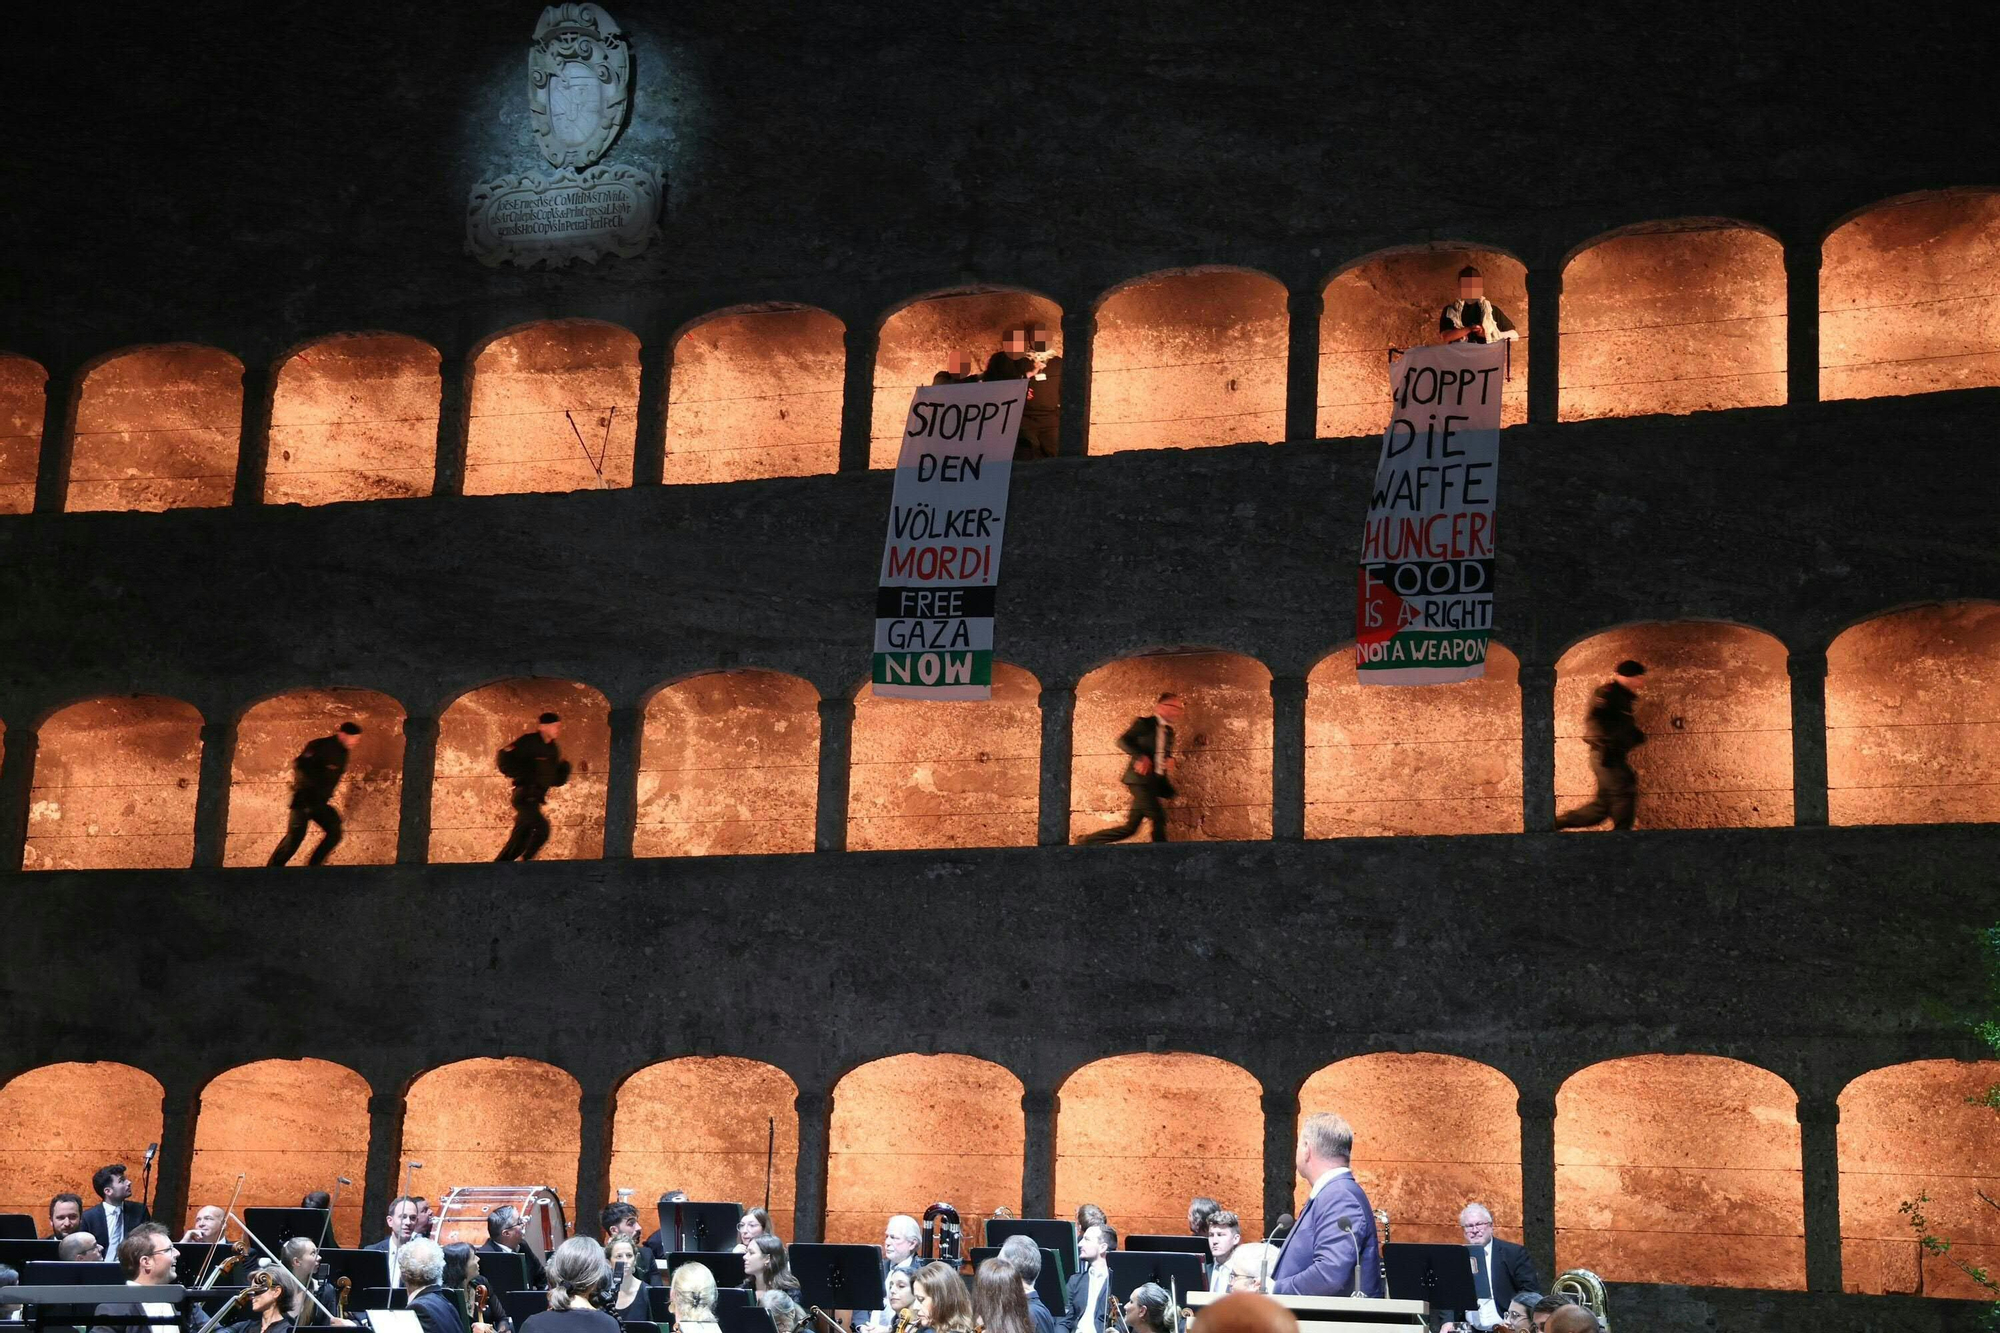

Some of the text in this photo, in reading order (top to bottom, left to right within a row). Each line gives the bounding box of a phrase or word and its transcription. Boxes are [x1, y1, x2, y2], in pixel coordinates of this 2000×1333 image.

[907, 399, 1018, 441] STOPPT
[917, 453, 983, 482] DEN
[1371, 462, 1492, 511] WAFFE
[894, 502, 1000, 541] VÖLKER-
[1362, 511, 1497, 561] HUNGER!
[888, 545, 991, 583] MORD!
[1365, 561, 1485, 599] FOOD
[901, 591, 964, 617] FREE
[1365, 600, 1492, 630] IS A RIGHT
[887, 619, 970, 649] GAZA
[1356, 637, 1488, 664] NOT A WEAPON
[885, 652, 973, 685] NOW
